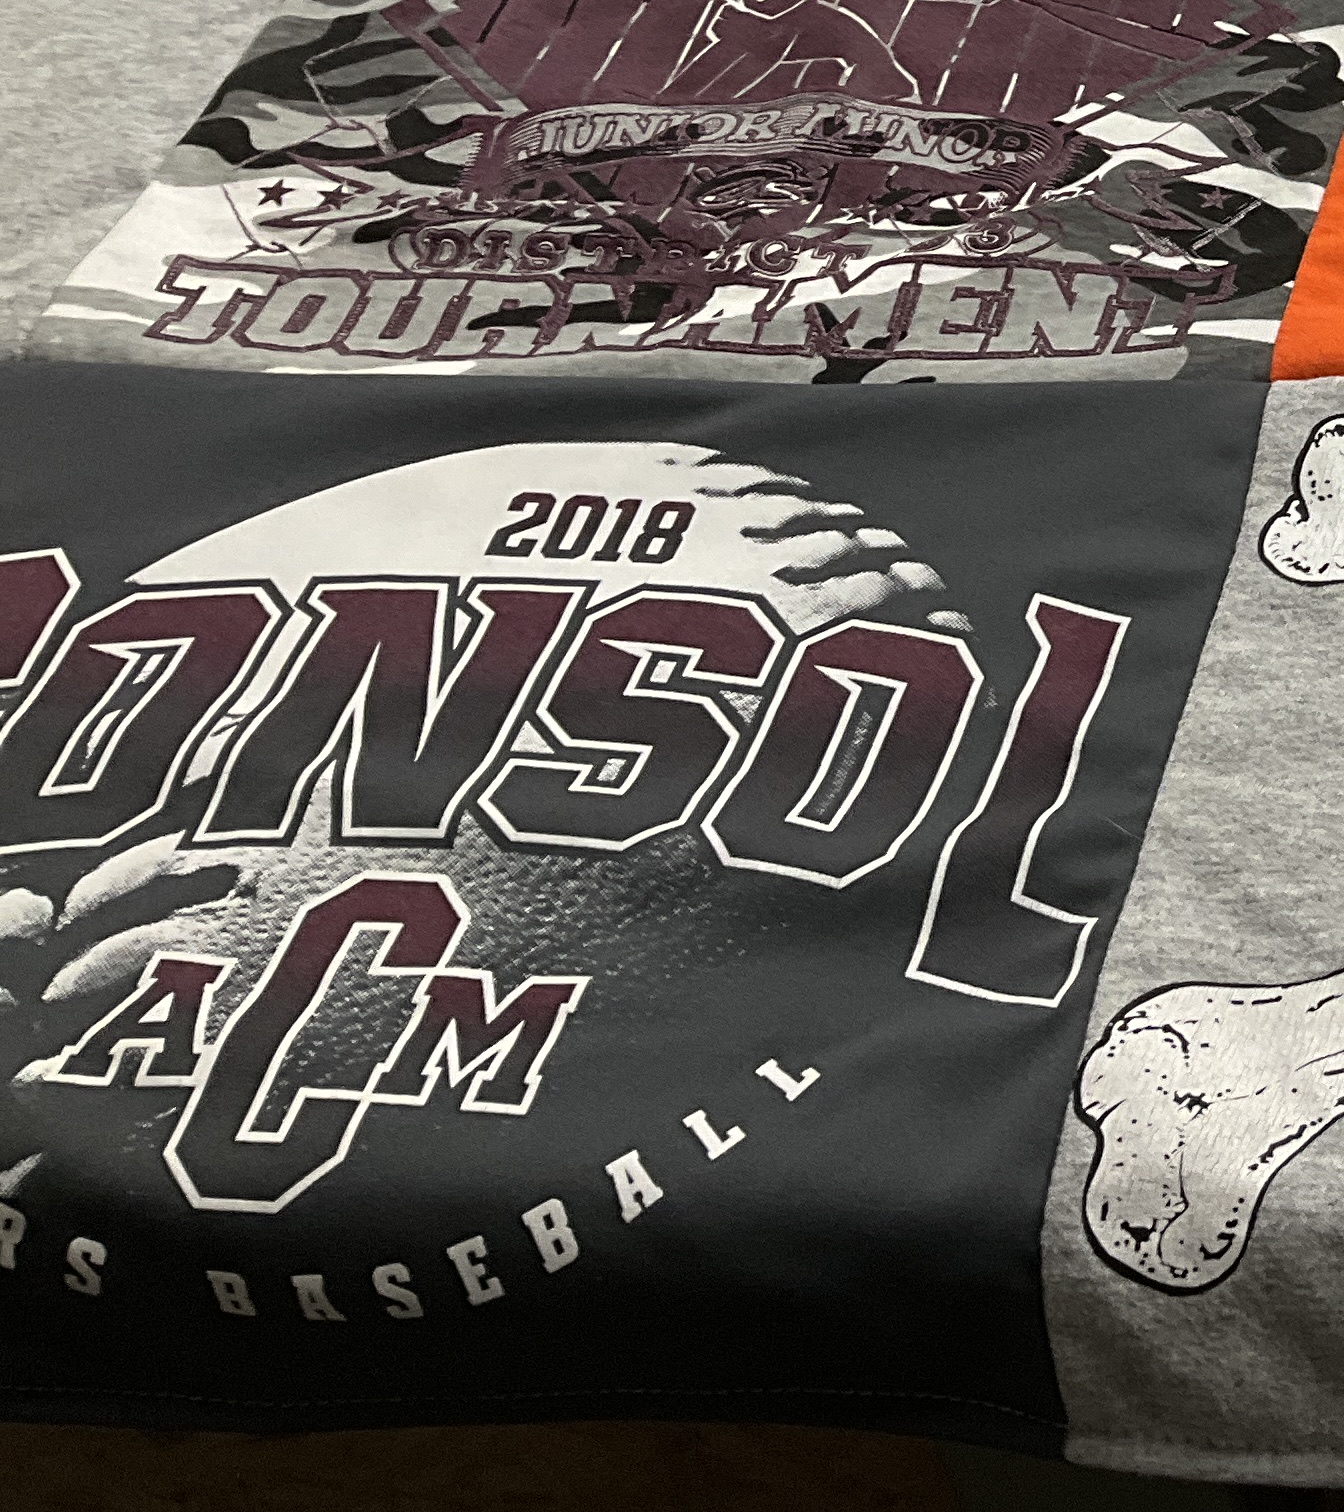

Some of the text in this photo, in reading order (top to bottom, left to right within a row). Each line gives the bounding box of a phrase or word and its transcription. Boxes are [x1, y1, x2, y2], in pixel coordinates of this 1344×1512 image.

[518, 102, 1040, 169] JUNIOR MINOR
[483, 489, 698, 568] 2018
[204, 1052, 823, 1327] BASEBALL
